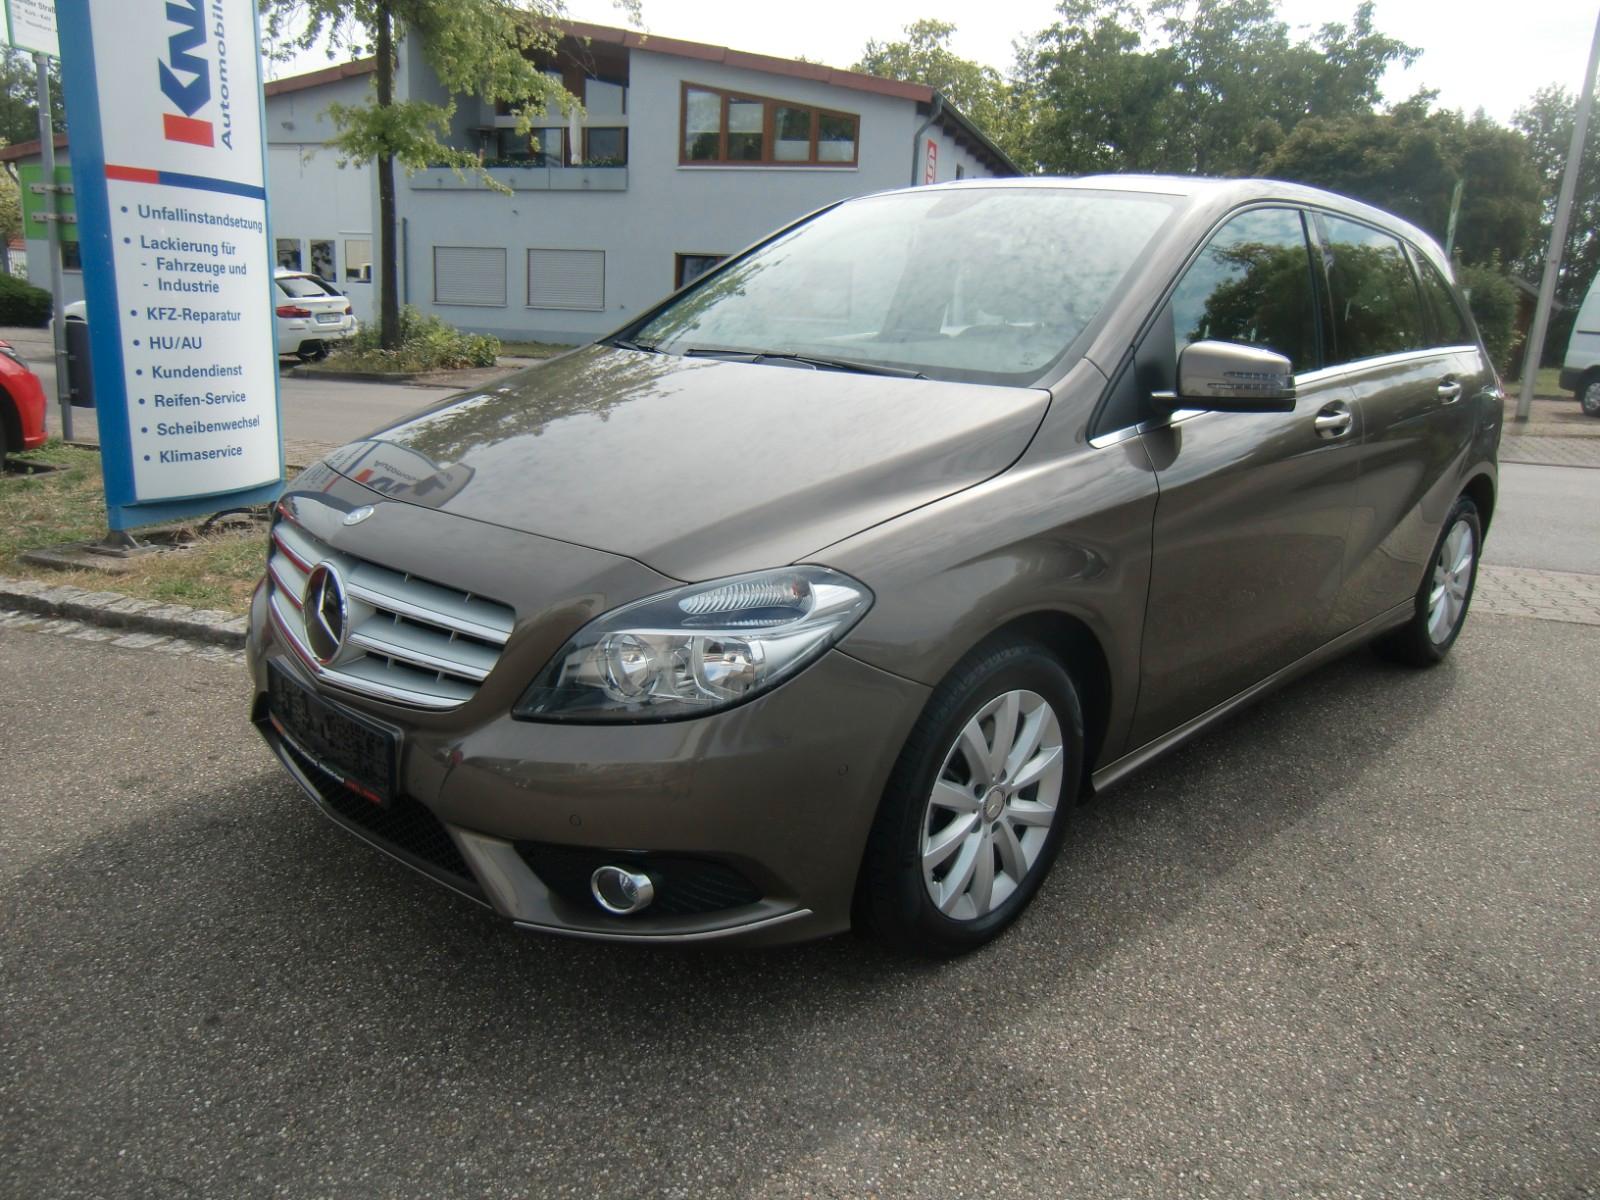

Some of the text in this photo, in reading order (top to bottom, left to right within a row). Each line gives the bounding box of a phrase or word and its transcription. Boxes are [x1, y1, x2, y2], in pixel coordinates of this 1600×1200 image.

[137, 204, 263, 233] Unfallinstandsetzung
[140, 235, 236, 256] Lackierung für
[156, 257, 247, 276] Fahrzeuge und
[158, 278, 220, 293] Industrie
[146, 307, 241, 323] KFZ-Reparatur
[149, 336, 202, 350] HU/AU
[152, 365, 243, 379] Kundendienst
[154, 391, 247, 407] Reifen-Service
[157, 415, 260, 436] Scheibenwechsel
[159, 445, 243, 463] Klimaservice
